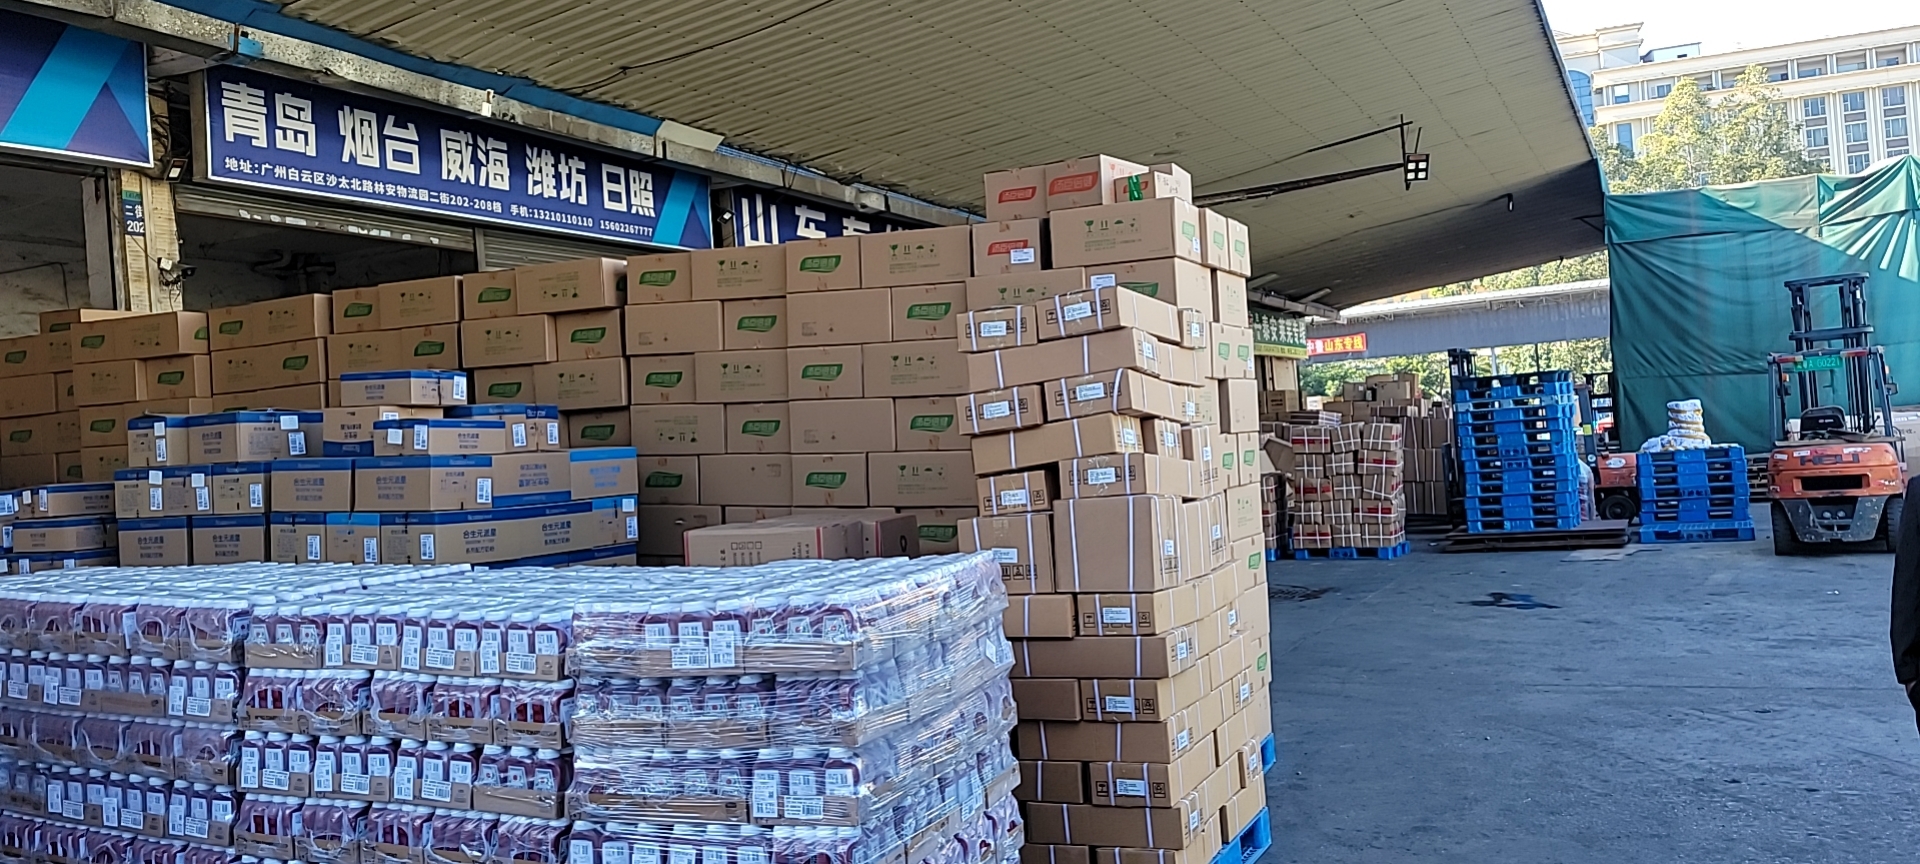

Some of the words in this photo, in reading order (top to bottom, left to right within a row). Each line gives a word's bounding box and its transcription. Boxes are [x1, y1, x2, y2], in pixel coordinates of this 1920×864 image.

[221, 81, 317, 157] 青岛
[338, 105, 420, 174] 烟台
[440, 129, 510, 191] 威海
[526, 143, 588, 205] 潍坊
[602, 163, 656, 218] 日照
[127, 220, 145, 233] 202
[510, 204, 593, 228] 手机:13210110110
[600, 219, 653, 237] 15602267777
